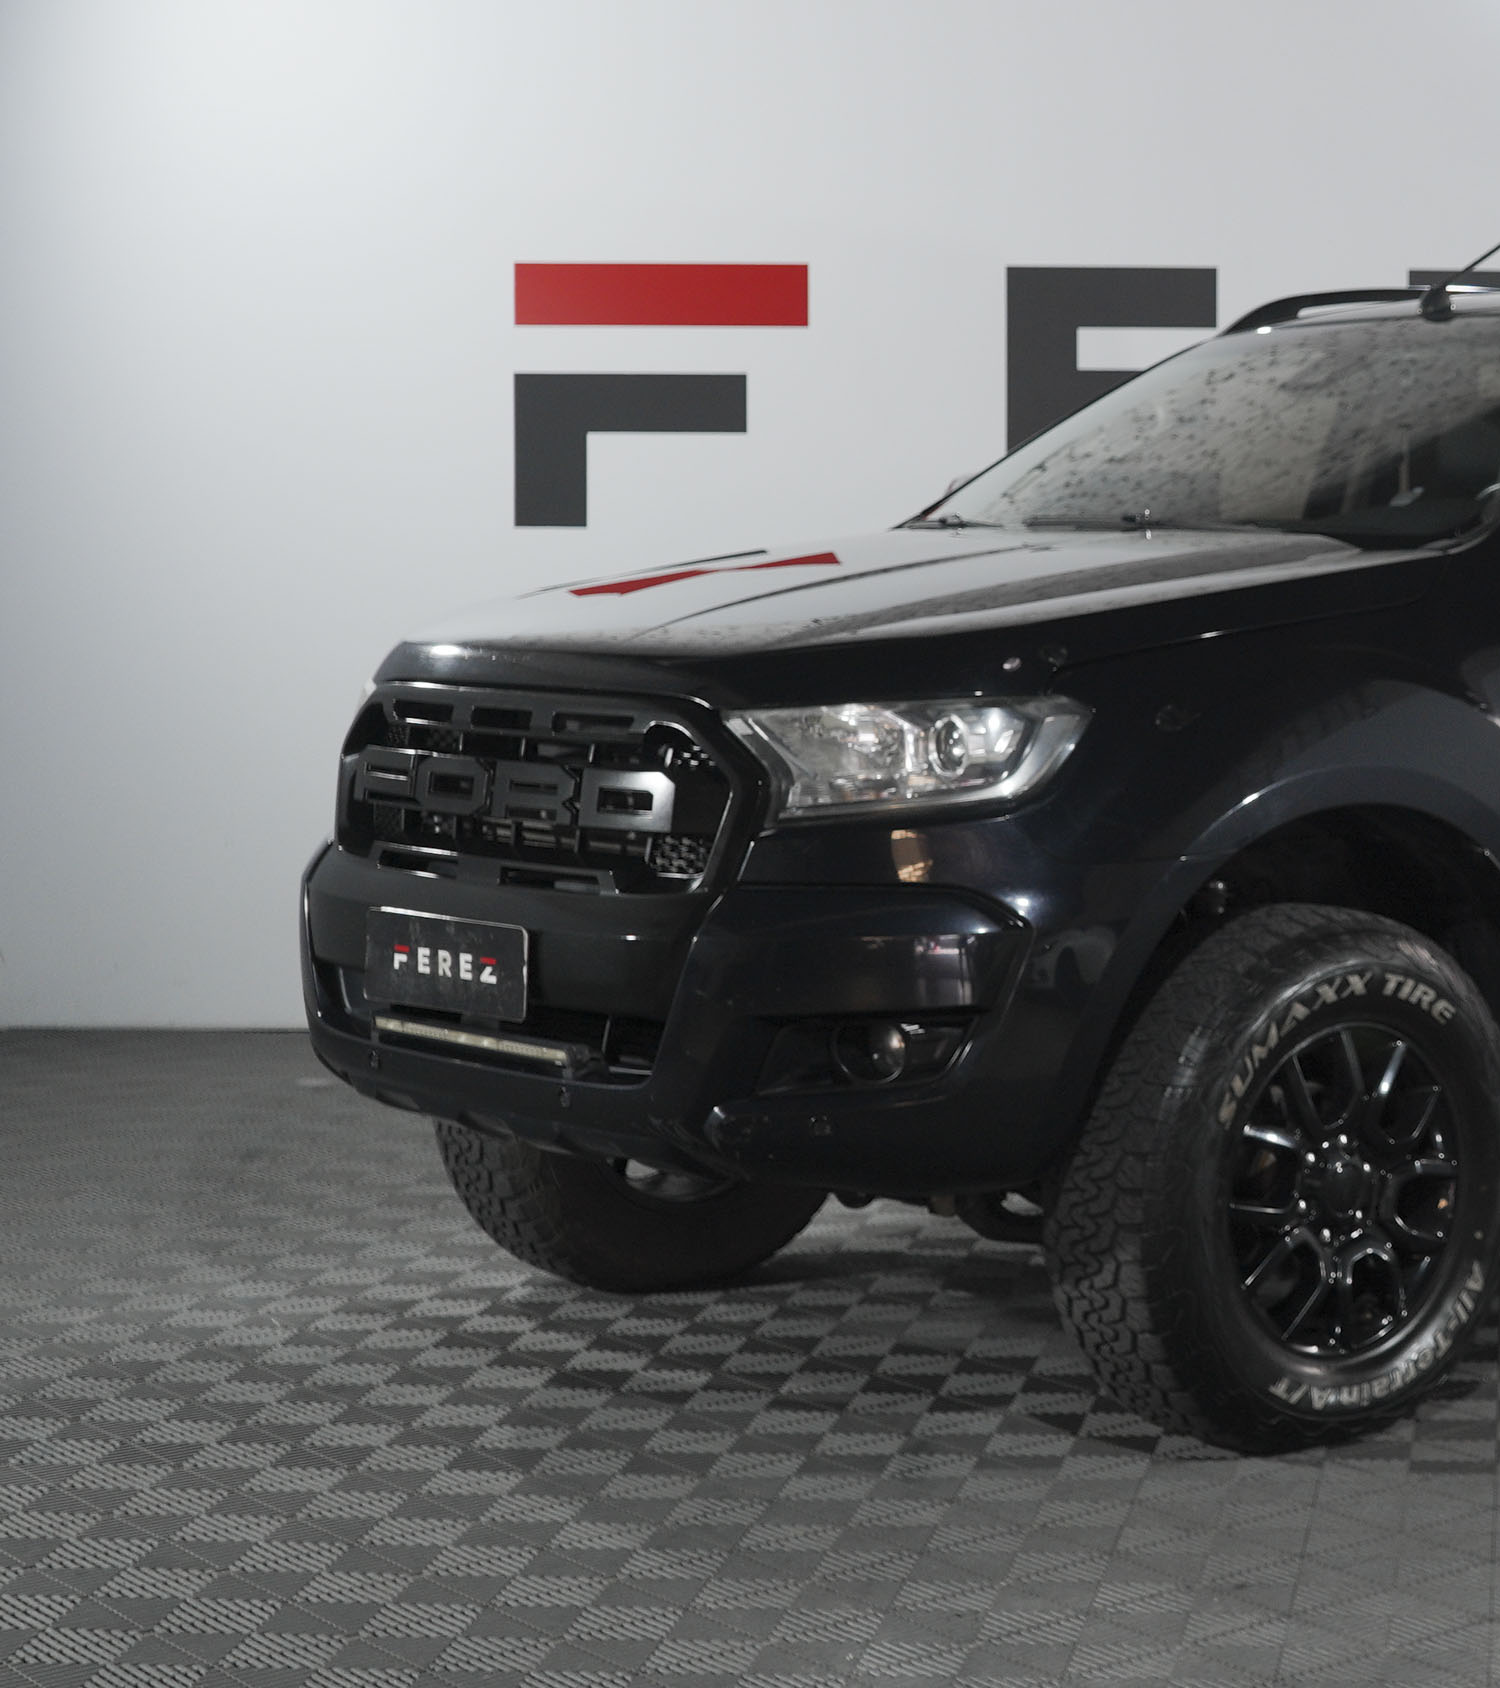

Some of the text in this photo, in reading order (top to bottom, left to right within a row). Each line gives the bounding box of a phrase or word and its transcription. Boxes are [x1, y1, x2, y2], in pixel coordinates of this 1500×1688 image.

[393, 944, 498, 985] FEREZ
[1218, 971, 1457, 1131] SUMAXX TIRE
